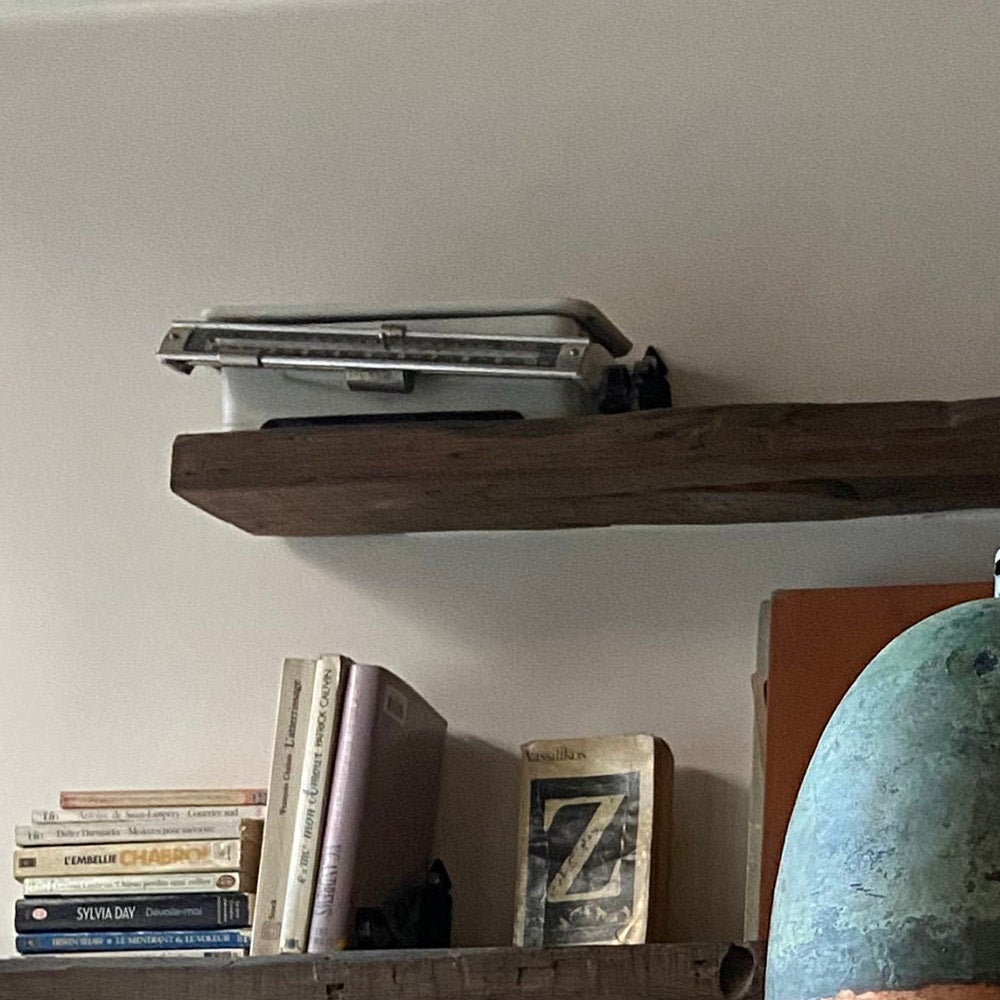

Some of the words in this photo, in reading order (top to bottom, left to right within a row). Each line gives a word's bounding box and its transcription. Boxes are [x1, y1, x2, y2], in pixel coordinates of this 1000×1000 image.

[320, 668, 332, 708] CAUVIN
[315, 711, 327, 747] PATRICK
[303, 810, 316, 840] mon
[63, 853, 117, 866] L'EMBELLIE
[543, 793, 626, 903] Z
[76, 906, 113, 921] SYLVIA
[114, 905, 136, 919] DAY
